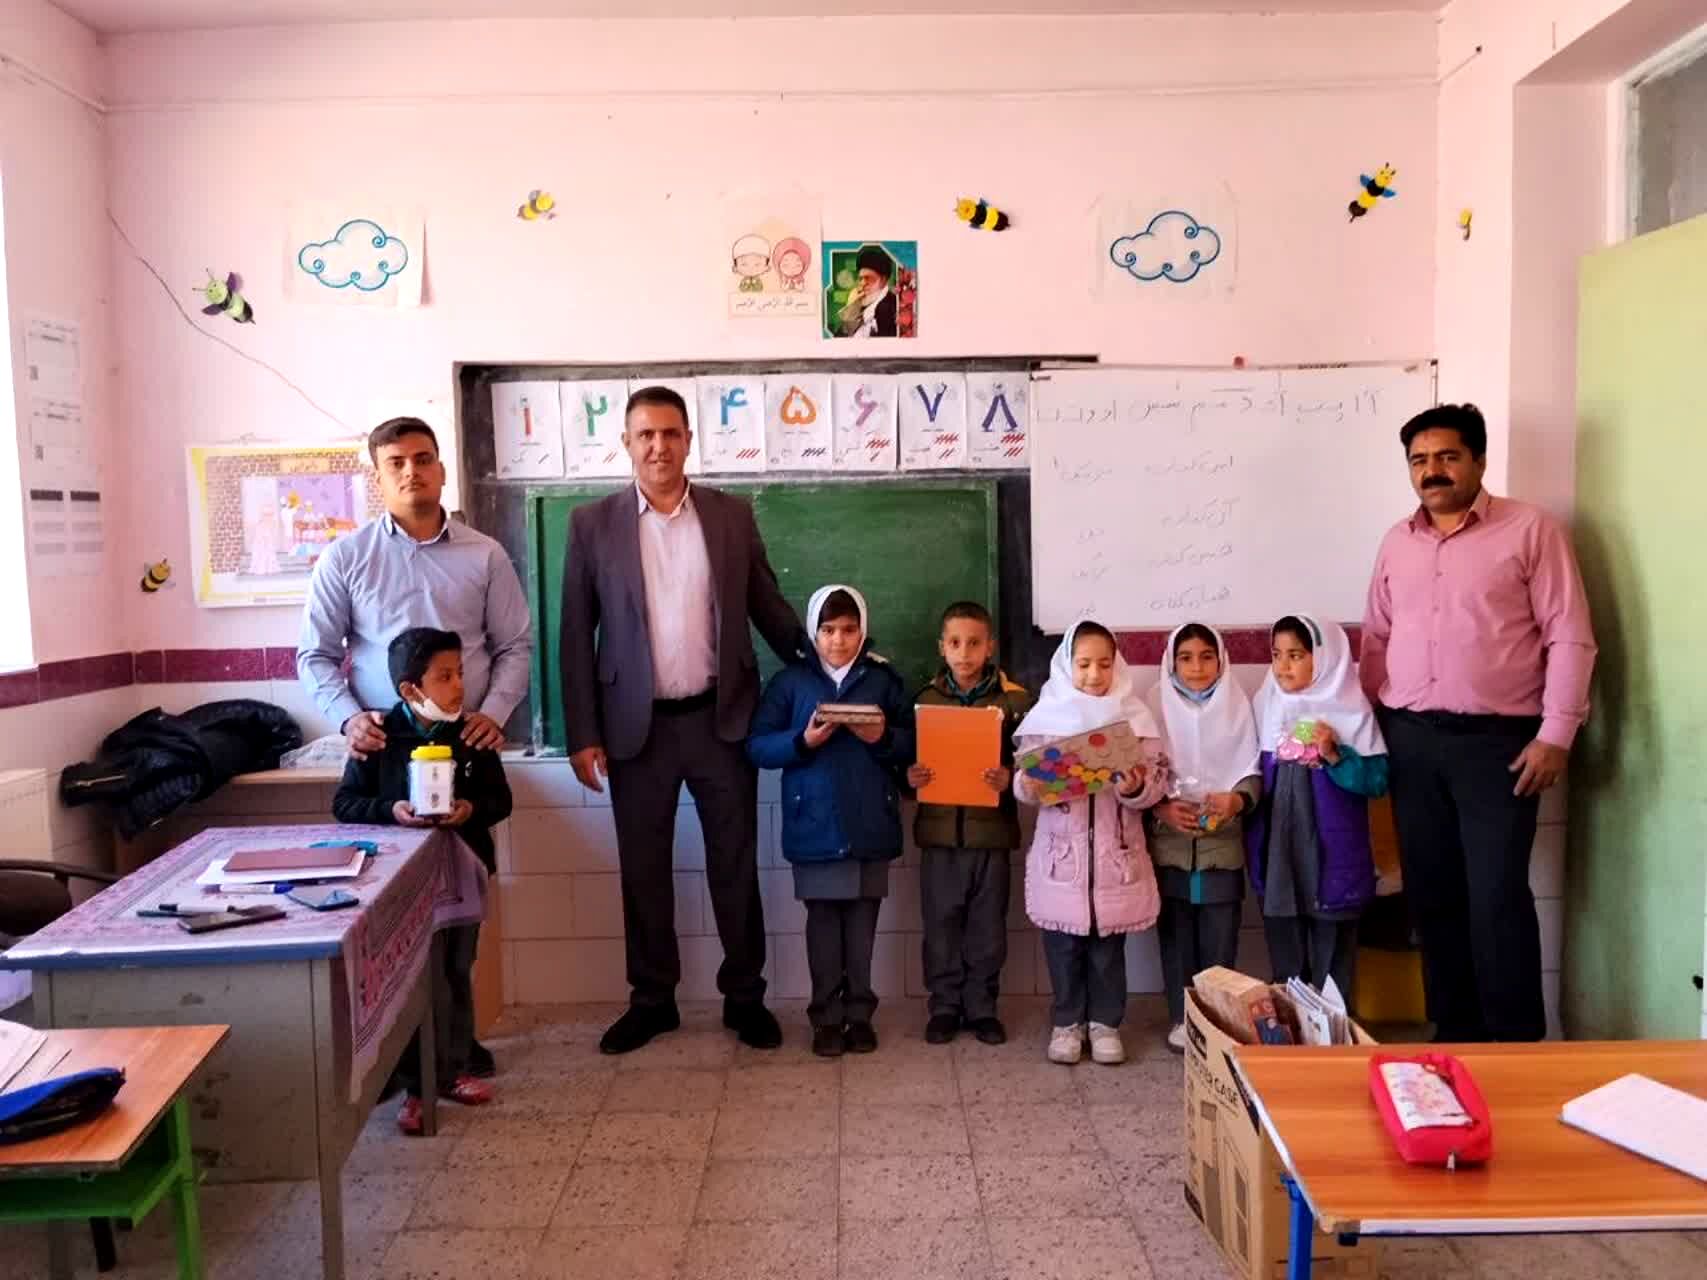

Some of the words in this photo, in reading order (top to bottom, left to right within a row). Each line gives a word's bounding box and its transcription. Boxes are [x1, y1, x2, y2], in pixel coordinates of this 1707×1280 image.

[584, 394, 608, 437] ۲
[720, 386, 748, 426] ۴
[780, 384, 817, 425] ۵
[854, 384, 878, 427] ۶
[916, 383, 948, 423] ۷
[981, 386, 1018, 432] ۸
